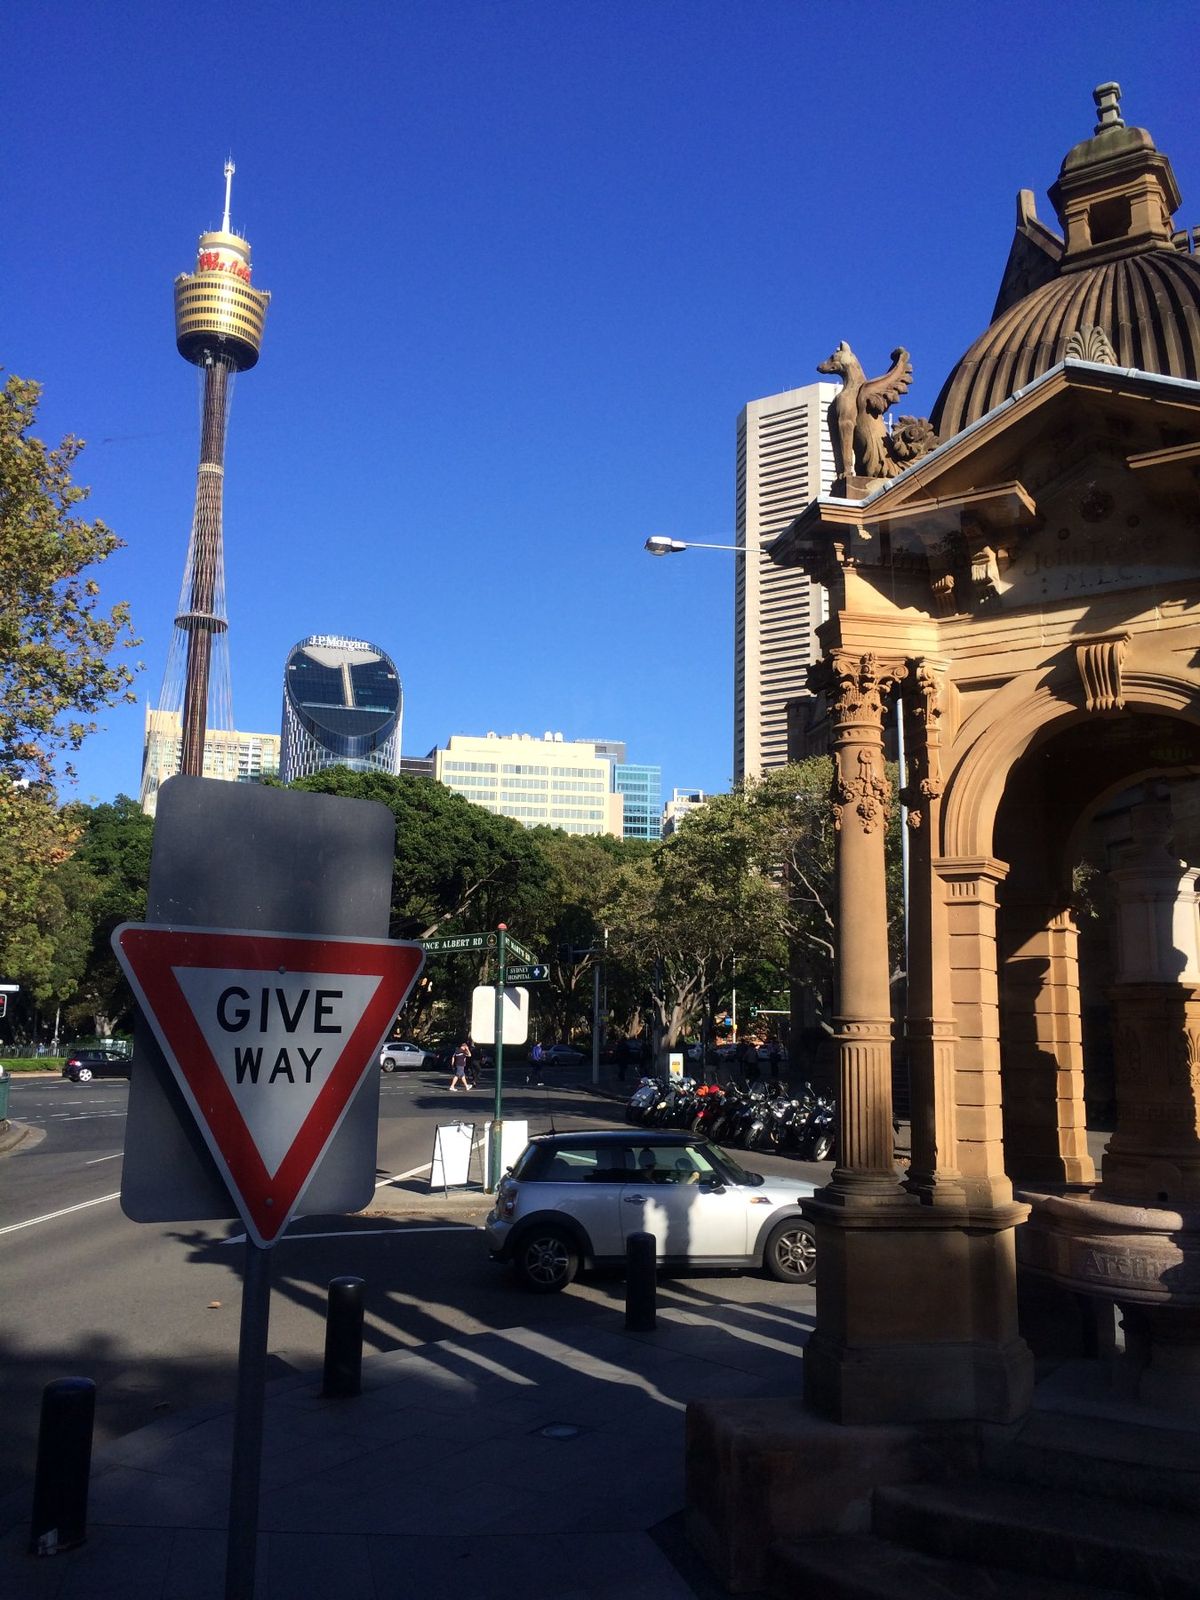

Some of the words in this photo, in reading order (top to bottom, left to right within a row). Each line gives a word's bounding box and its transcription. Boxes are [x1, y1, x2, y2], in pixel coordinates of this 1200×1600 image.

[442, 939, 470, 949] ALBERT
[473, 938, 483, 946] RD
[217, 986, 343, 1033] GIVE
[234, 1047, 322, 1084] WAY
